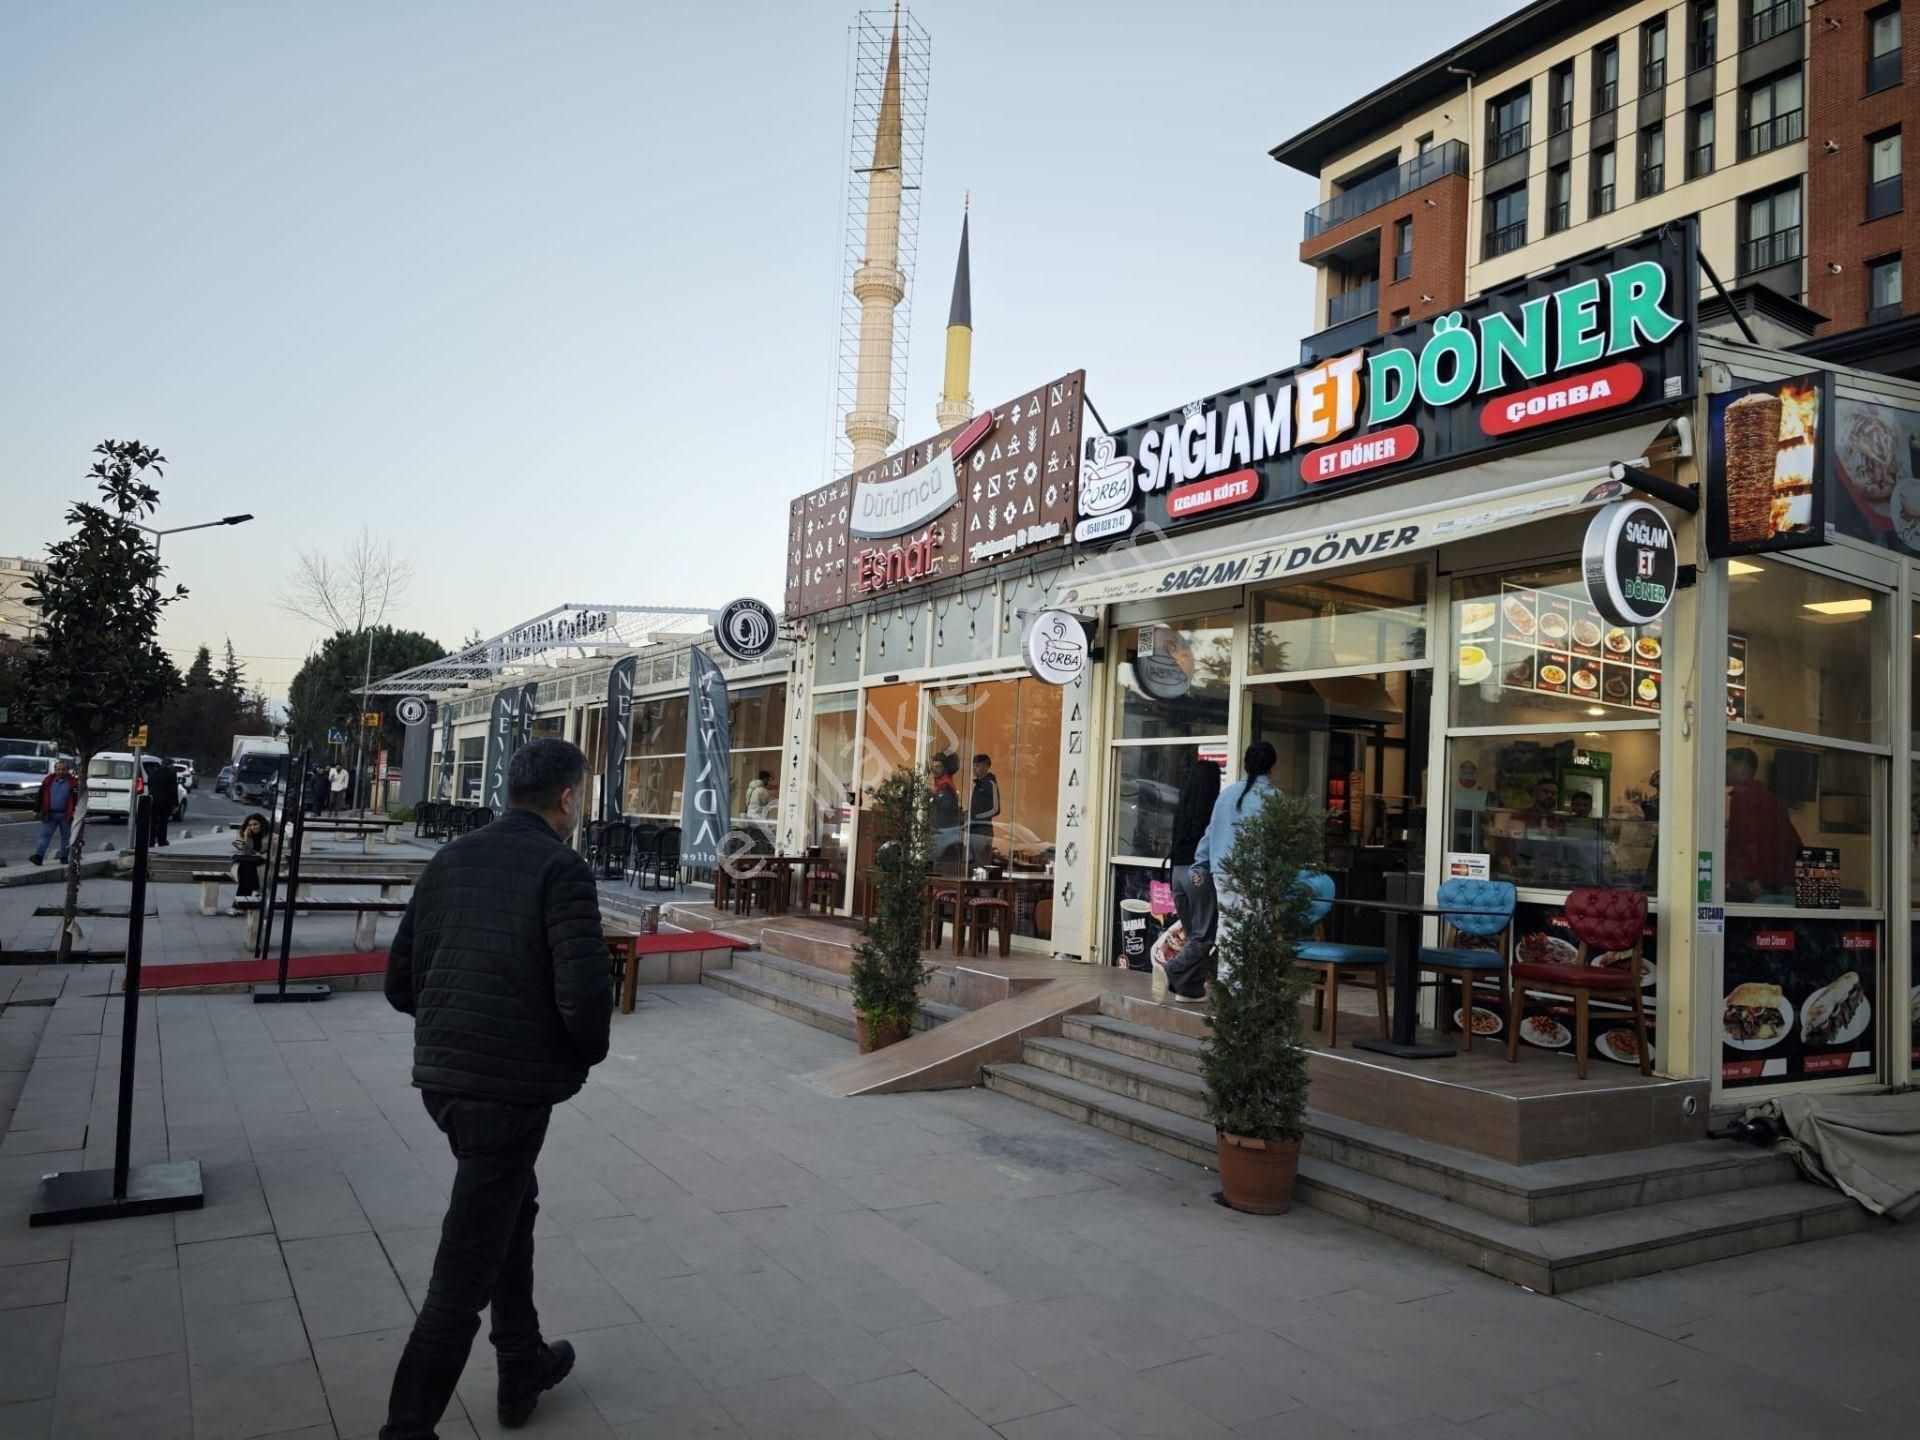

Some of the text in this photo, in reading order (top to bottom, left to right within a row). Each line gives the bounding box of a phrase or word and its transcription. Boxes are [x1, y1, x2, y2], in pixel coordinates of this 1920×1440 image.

[1294, 349, 1363, 448] ET
[1367, 261, 1683, 427] DÖNER
[1505, 379, 1612, 423] ÇORBA
[1319, 437, 1396, 475] ET DÖNER
[862, 466, 943, 518] Dürümcü
[1173, 479, 1249, 512] IZGARA KÖFTE
[1244, 547, 1287, 580] ET
[1284, 525, 1420, 571] DÖNER
[1626, 520, 1668, 549] SAĞLAM
[857, 522, 940, 592] Esnaf
[1637, 550, 1656, 577] ET
[731, 602, 766, 614] NEVADA
[1624, 576, 1668, 604] DÖNER
